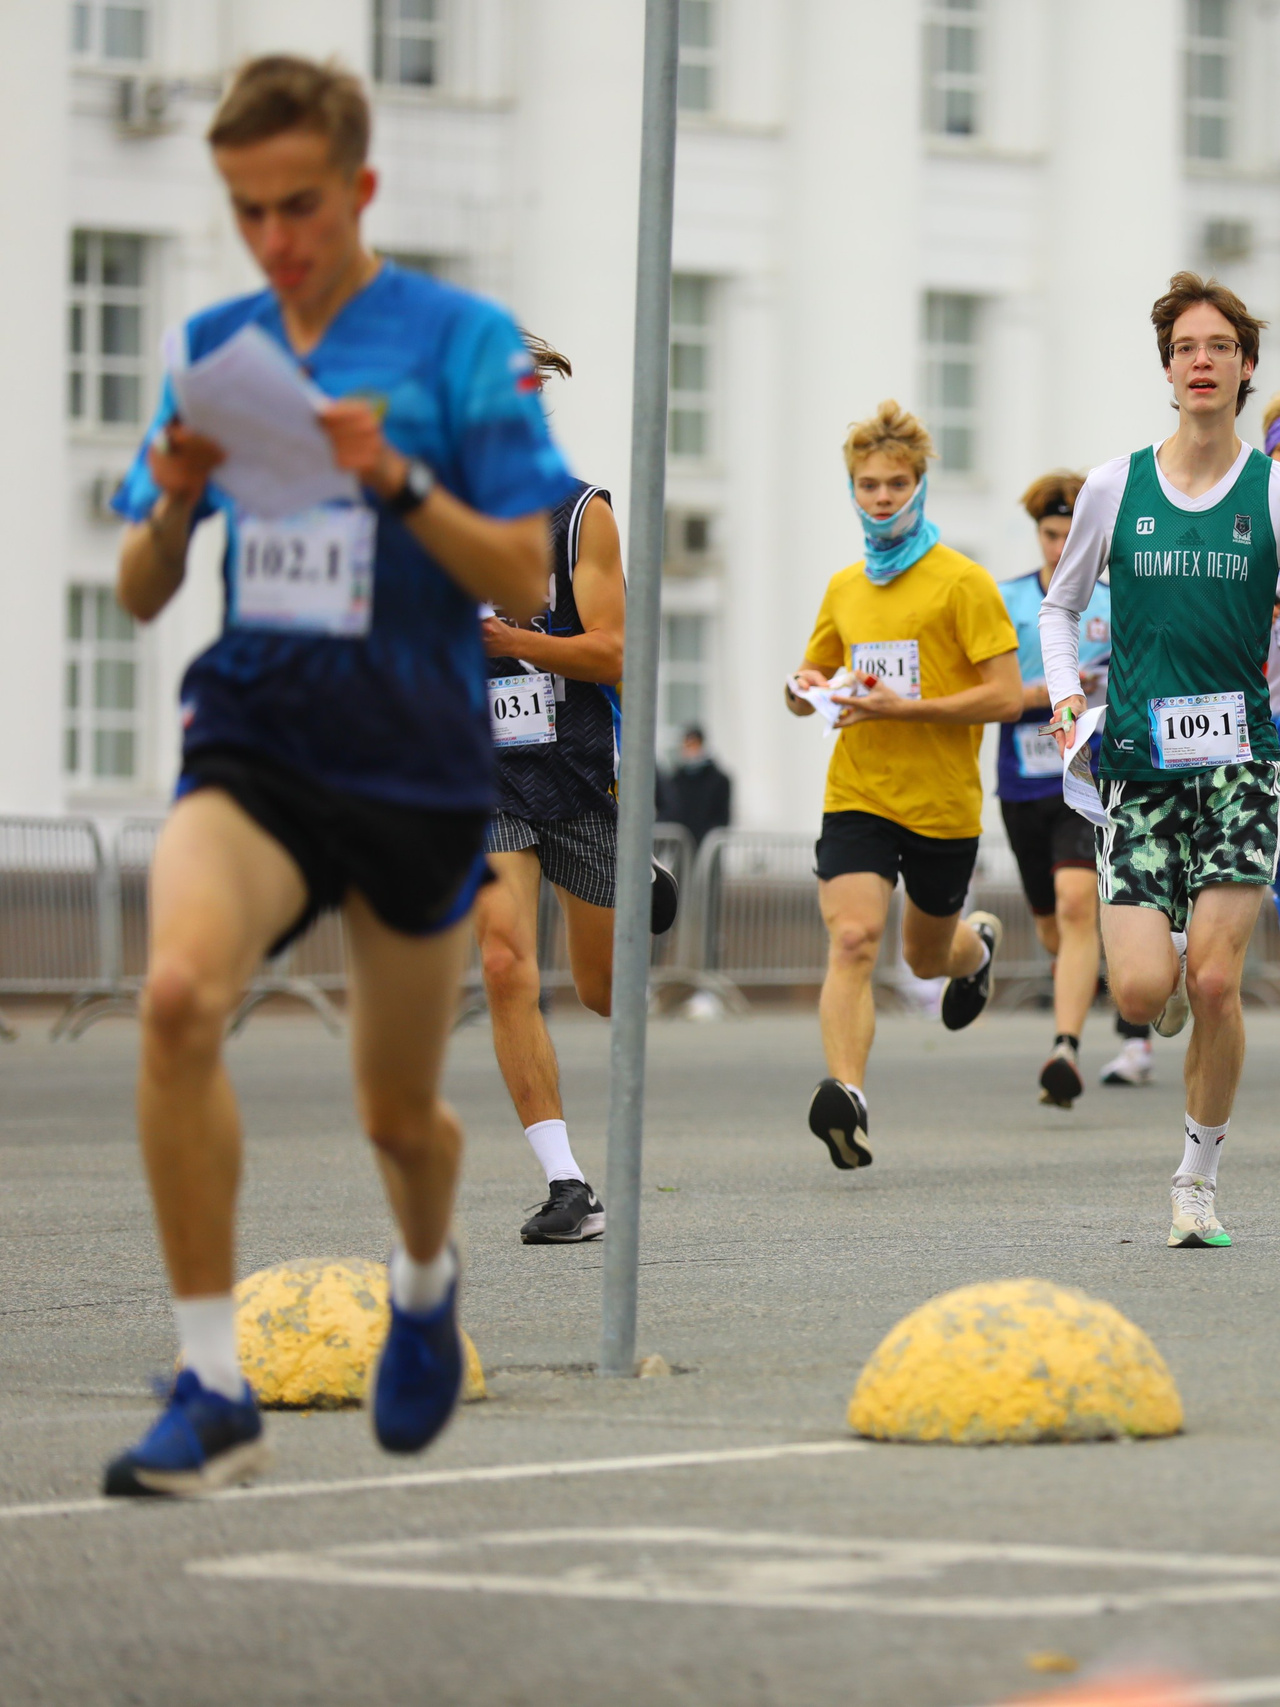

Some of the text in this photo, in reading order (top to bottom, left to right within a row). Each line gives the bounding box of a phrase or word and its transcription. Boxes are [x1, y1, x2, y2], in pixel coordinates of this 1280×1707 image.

[244, 538, 341, 580] 102.1
[1134, 550, 1249, 581] ПОЛИТЕХ ПЕТРА
[858, 657, 904, 678] 108.1
[494, 691, 543, 720] 03.1
[1164, 711, 1233, 740] 109.1
